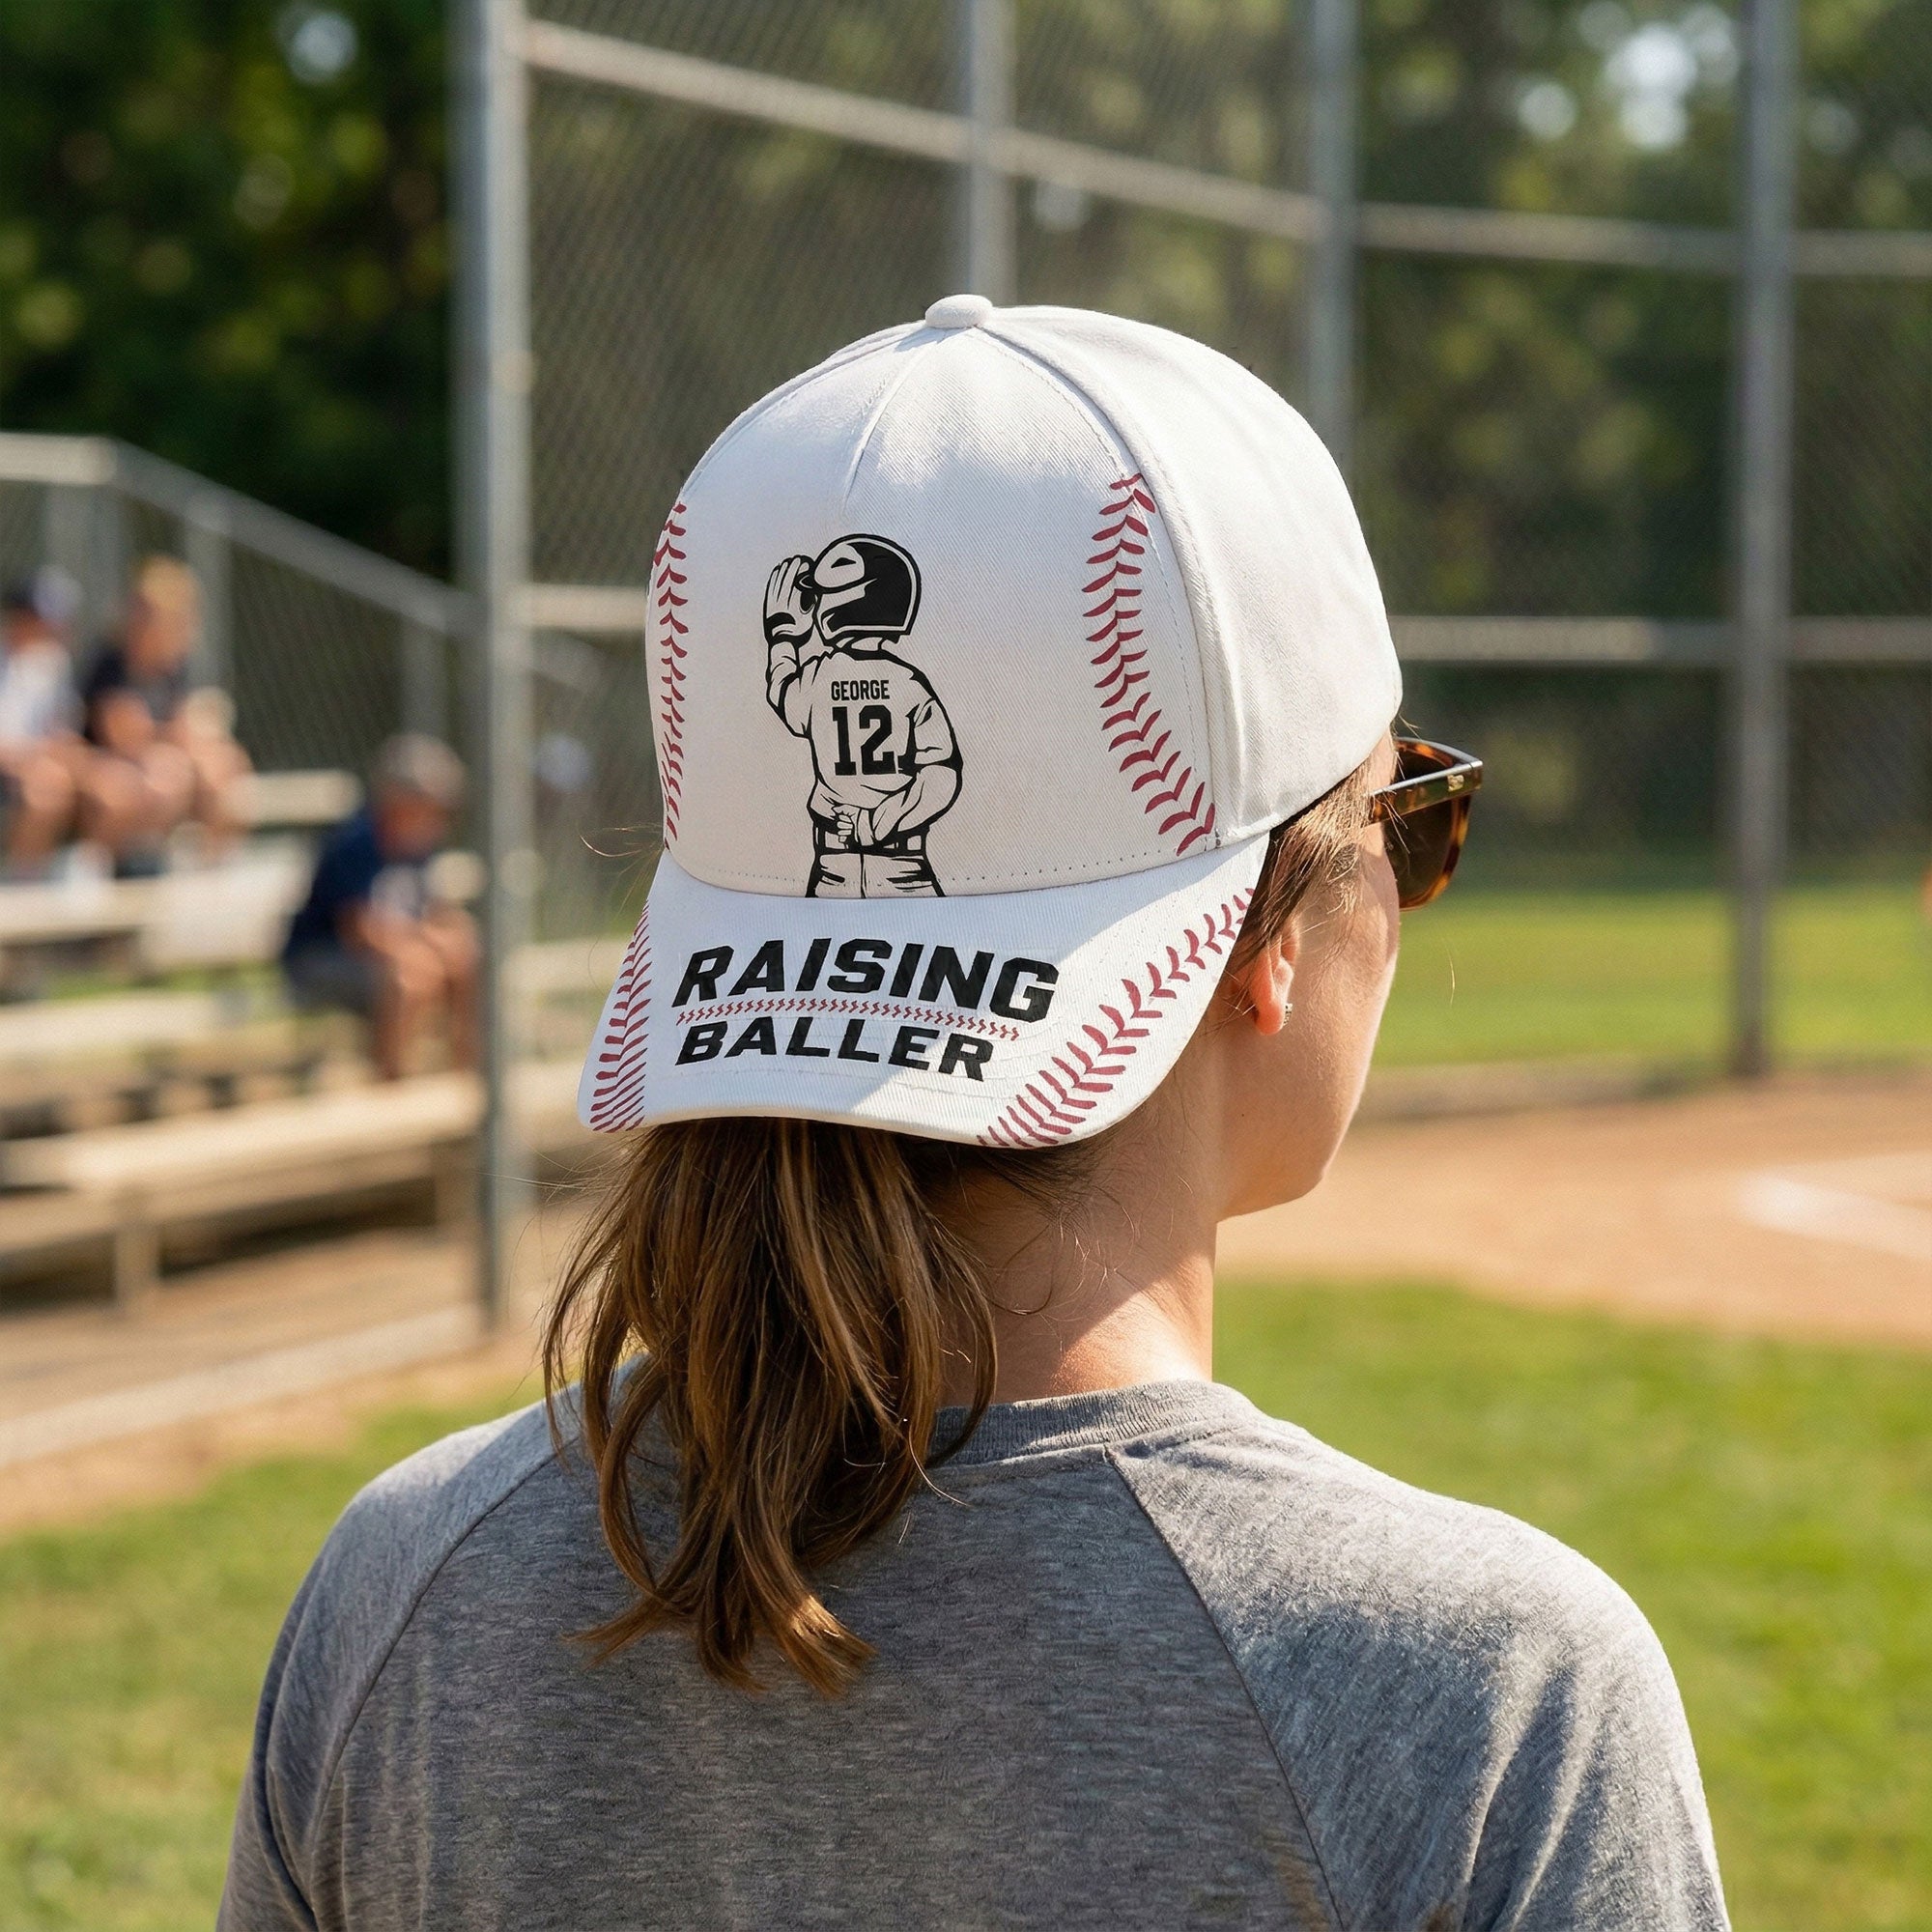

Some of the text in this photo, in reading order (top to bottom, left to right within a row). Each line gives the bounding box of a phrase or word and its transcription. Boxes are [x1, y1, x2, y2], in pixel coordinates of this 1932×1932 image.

[831, 679, 891, 701] GEORGE
[832, 704, 897, 776] 12
[671, 938, 1060, 1023] RAISING
[674, 1016, 994, 1082] BALLER
